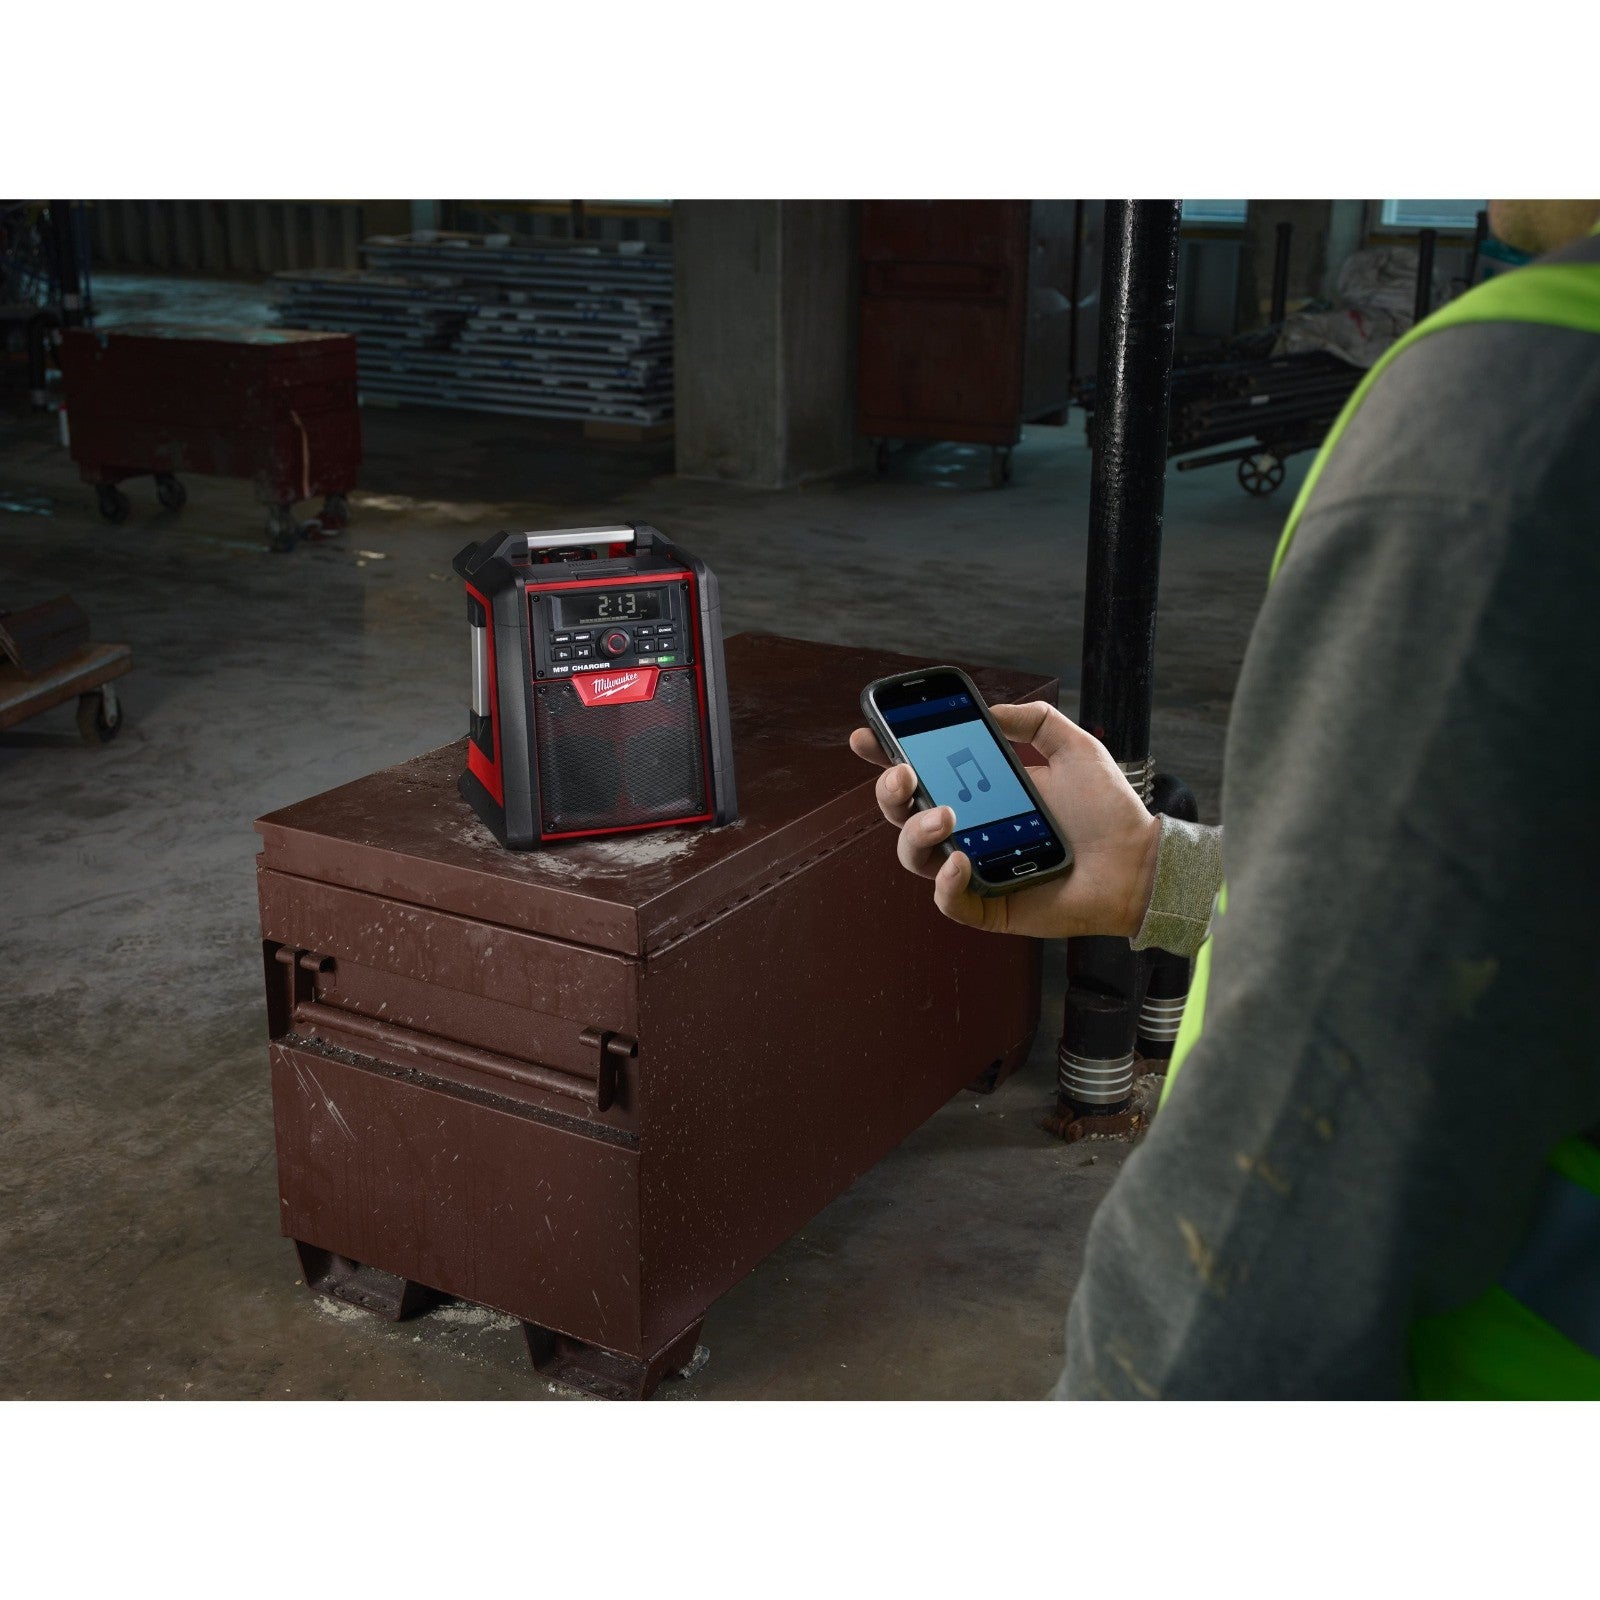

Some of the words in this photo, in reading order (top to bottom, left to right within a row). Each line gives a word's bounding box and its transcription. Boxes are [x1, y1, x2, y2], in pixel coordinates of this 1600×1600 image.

[598, 593, 636, 616] 2:13
[572, 662, 610, 671] CHARGER
[591, 672, 638, 695] Milwaukee
